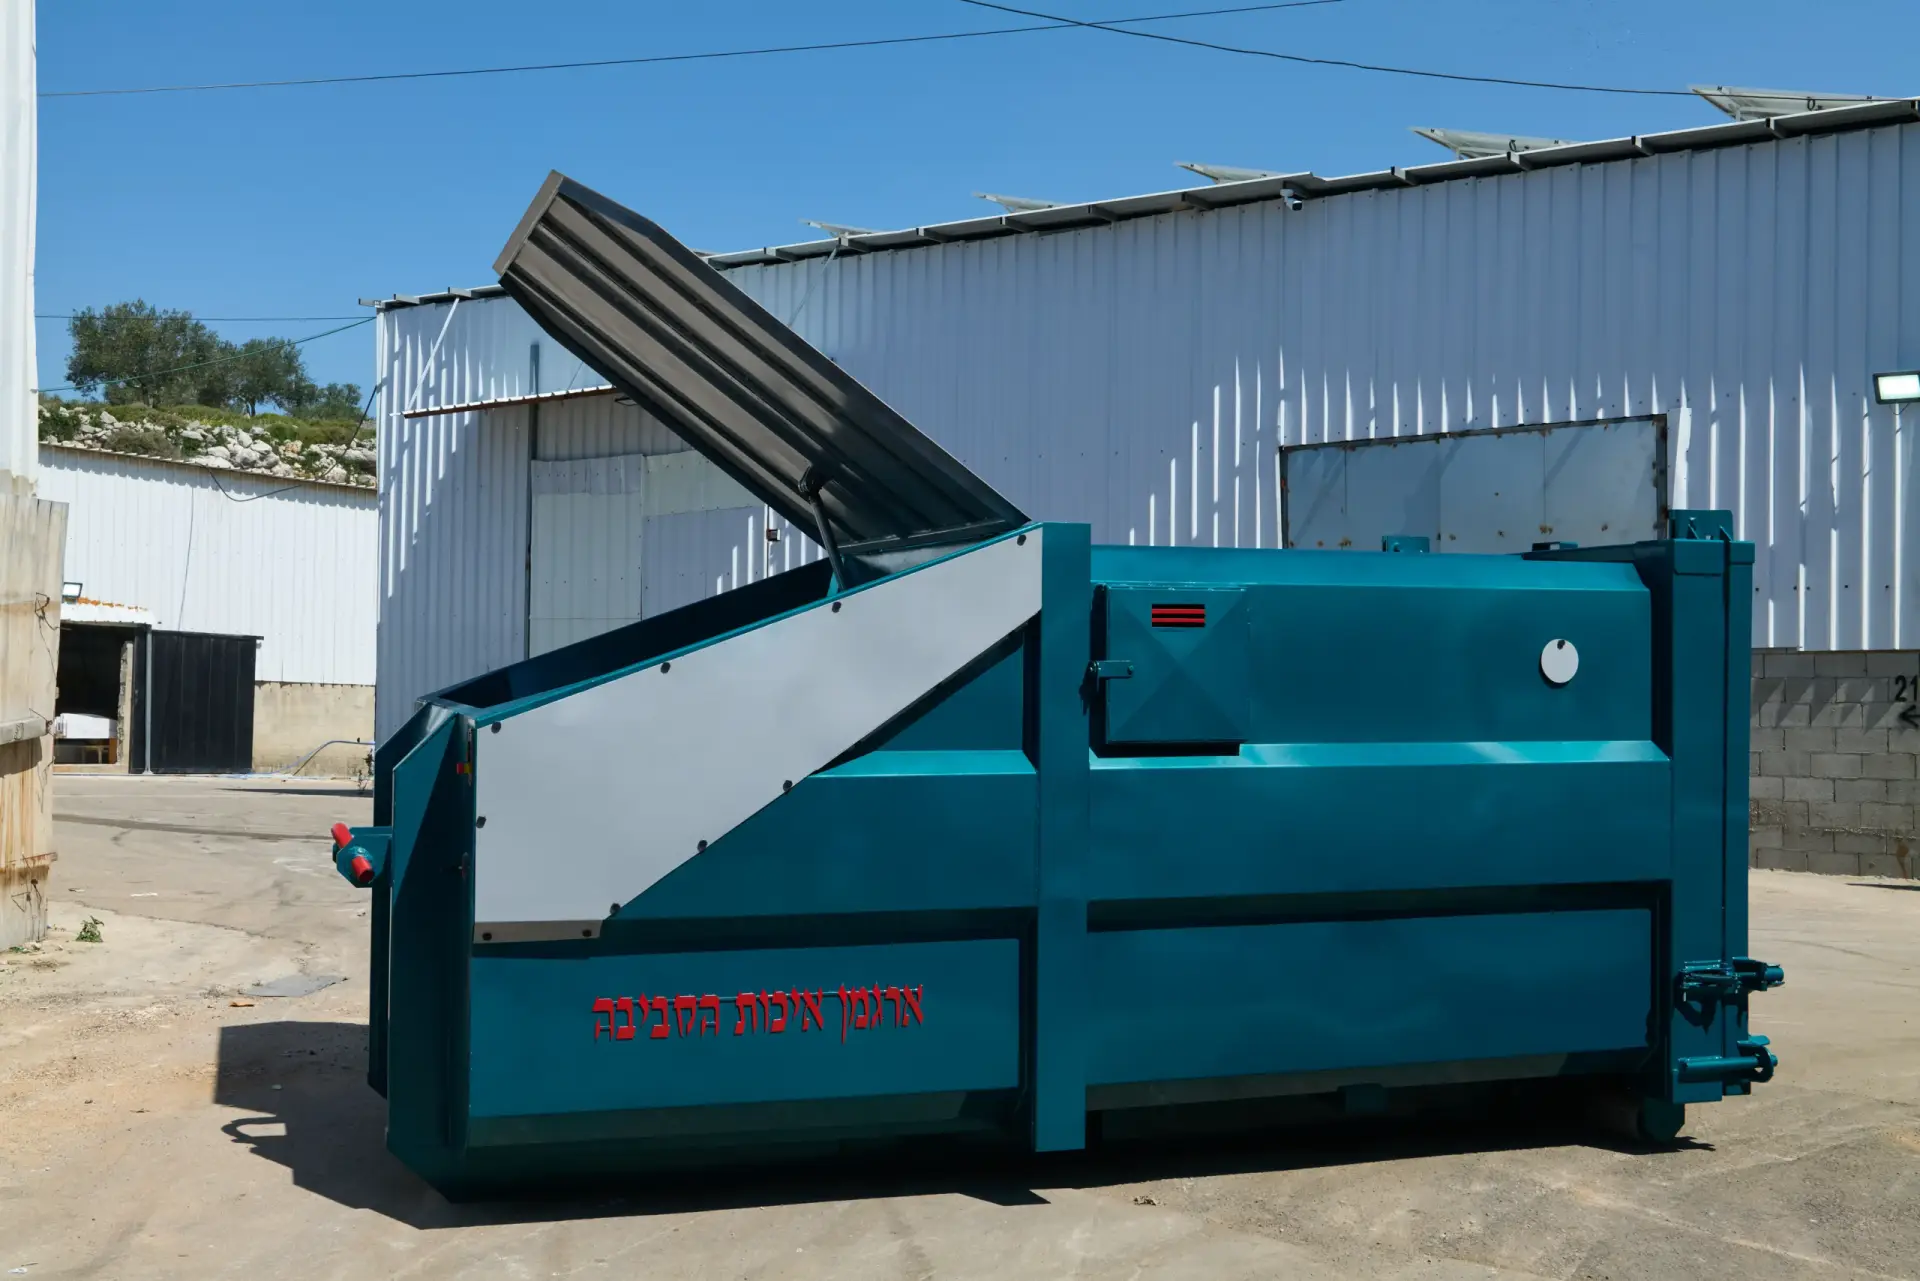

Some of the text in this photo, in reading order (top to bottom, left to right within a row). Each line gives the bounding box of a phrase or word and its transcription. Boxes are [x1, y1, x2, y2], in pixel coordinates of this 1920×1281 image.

[1895, 674, 1918, 702] 21
[734, 986, 824, 1036] איכות
[838, 984, 924, 1045] ארגמן
